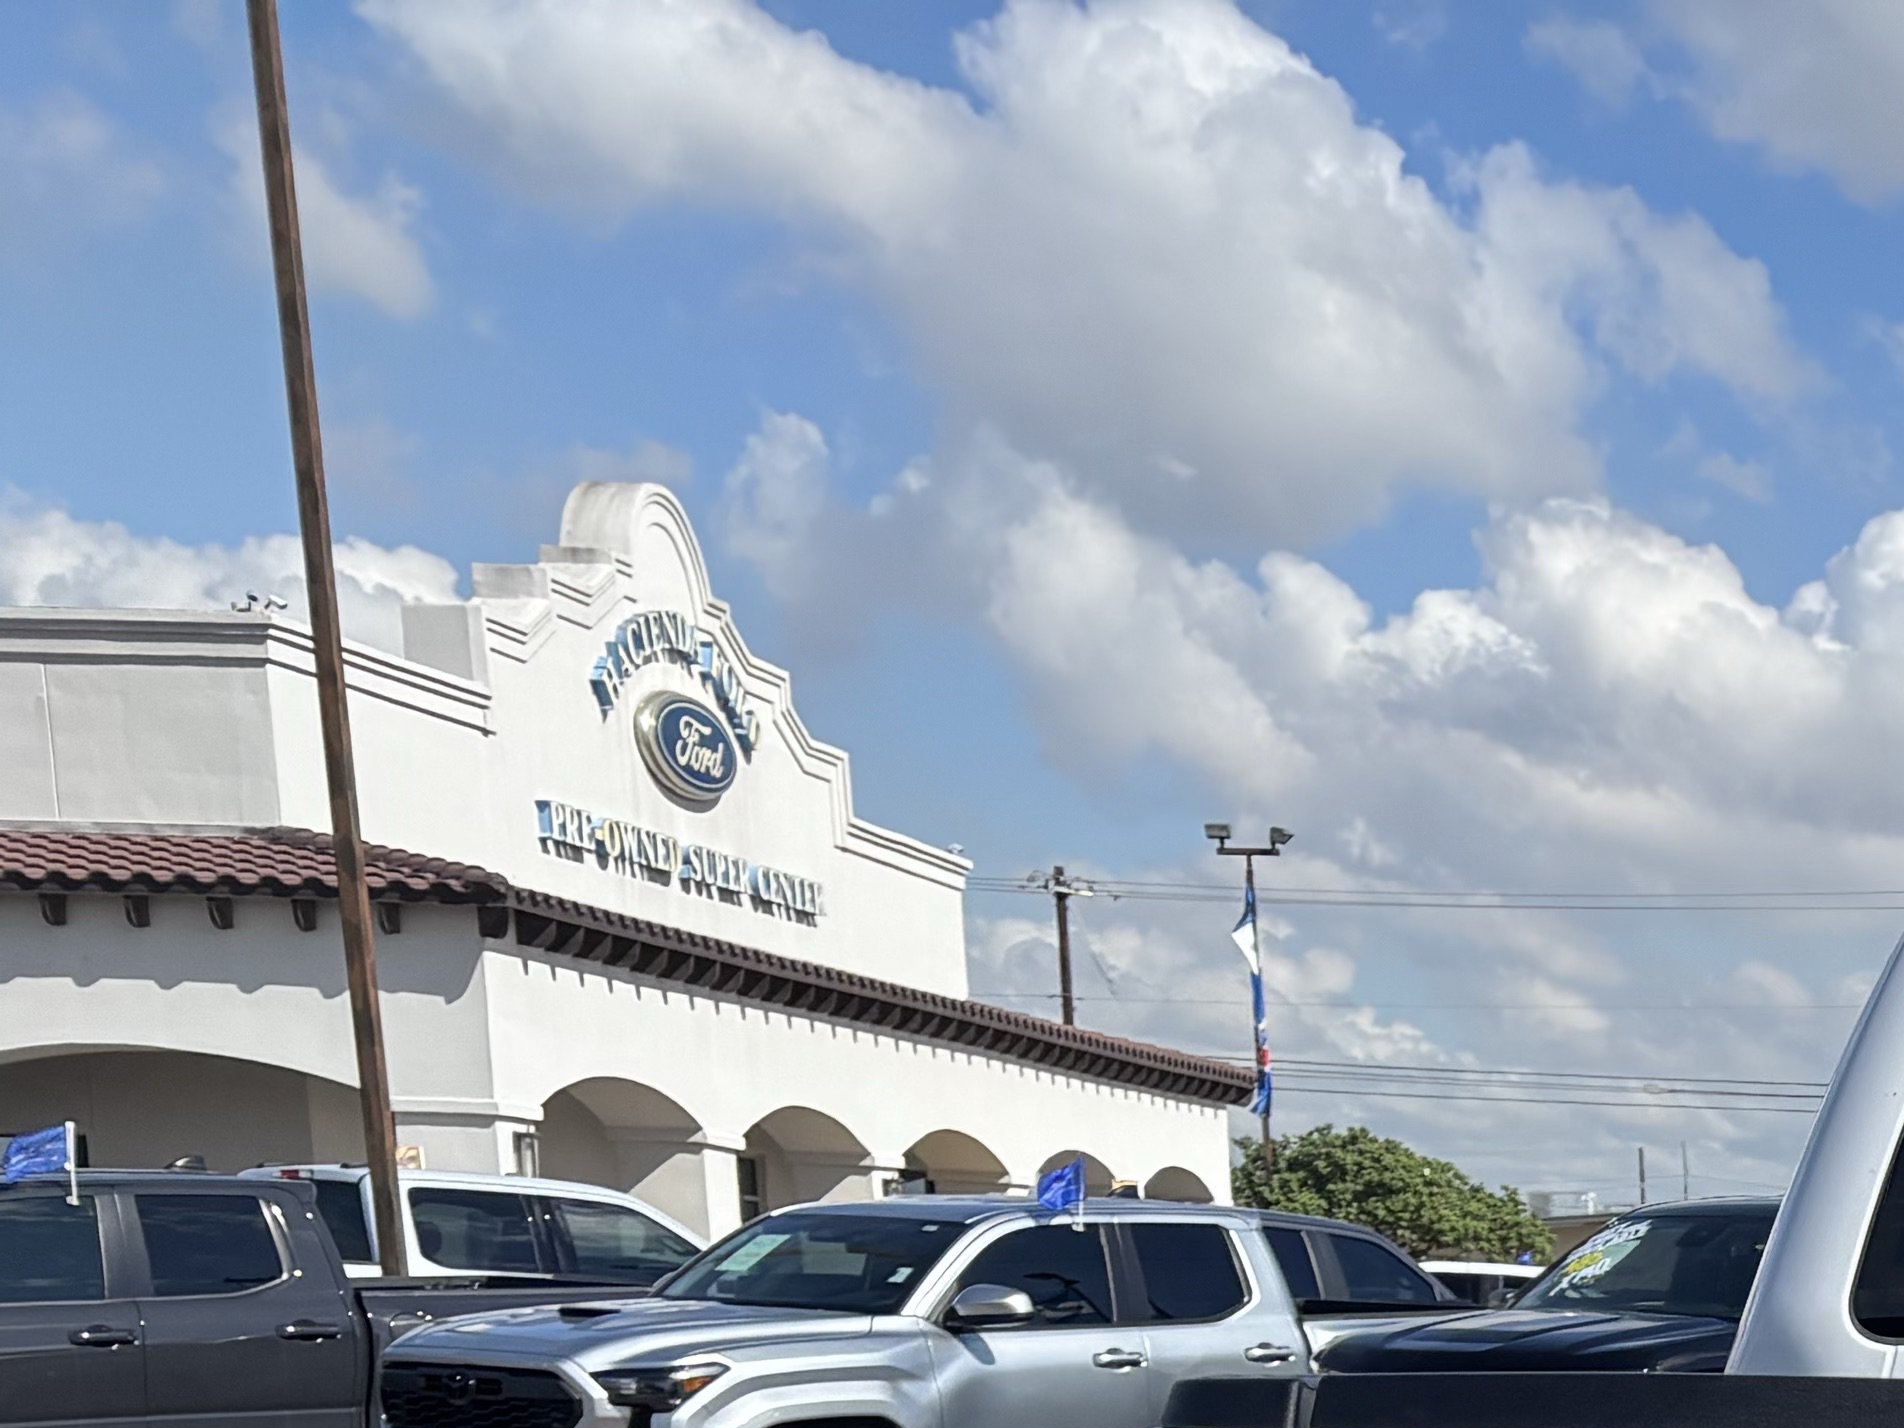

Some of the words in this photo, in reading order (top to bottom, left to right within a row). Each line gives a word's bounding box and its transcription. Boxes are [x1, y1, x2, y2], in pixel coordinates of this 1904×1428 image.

[674, 714, 724, 779] Ford
[535, 800, 682, 874] PRE-OWNED
[682, 845, 752, 898] SUPER
